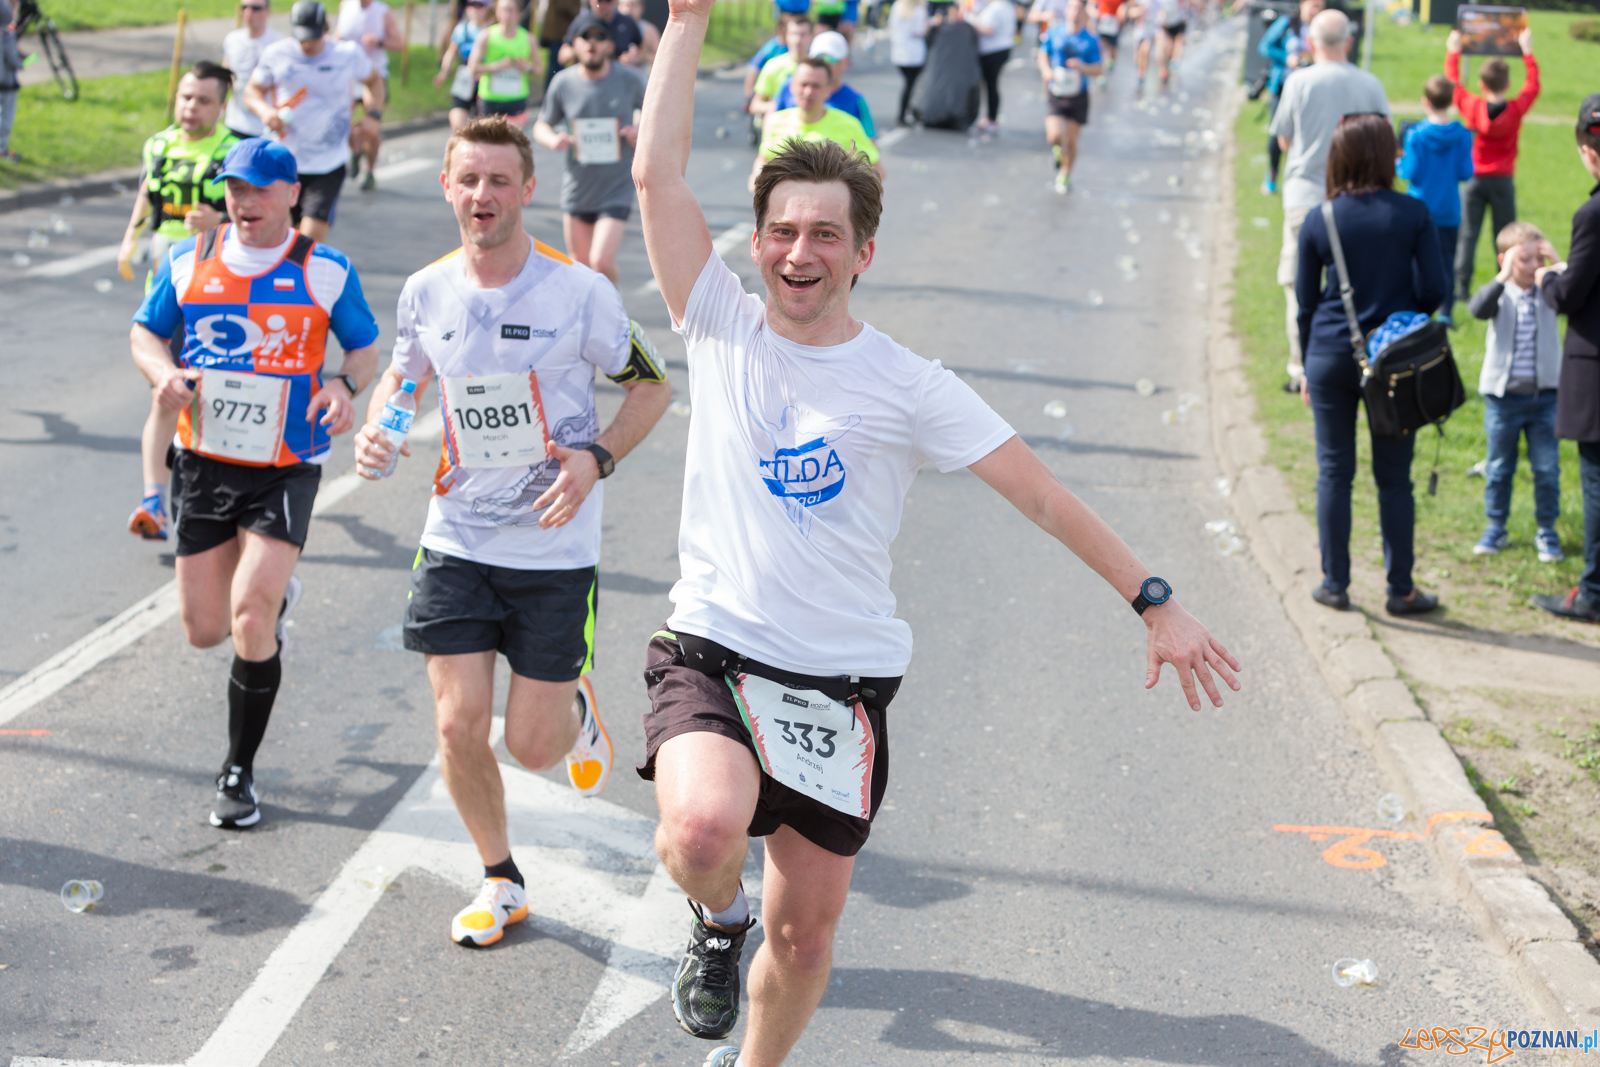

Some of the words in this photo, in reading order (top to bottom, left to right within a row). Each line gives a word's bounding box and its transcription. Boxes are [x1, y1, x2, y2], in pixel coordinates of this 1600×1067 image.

[212, 398, 267, 425] 9773
[454, 402, 531, 430] 10881
[482, 433, 508, 441] Marcin
[773, 717, 838, 759] 333
[796, 752, 824, 774] Andrzej
